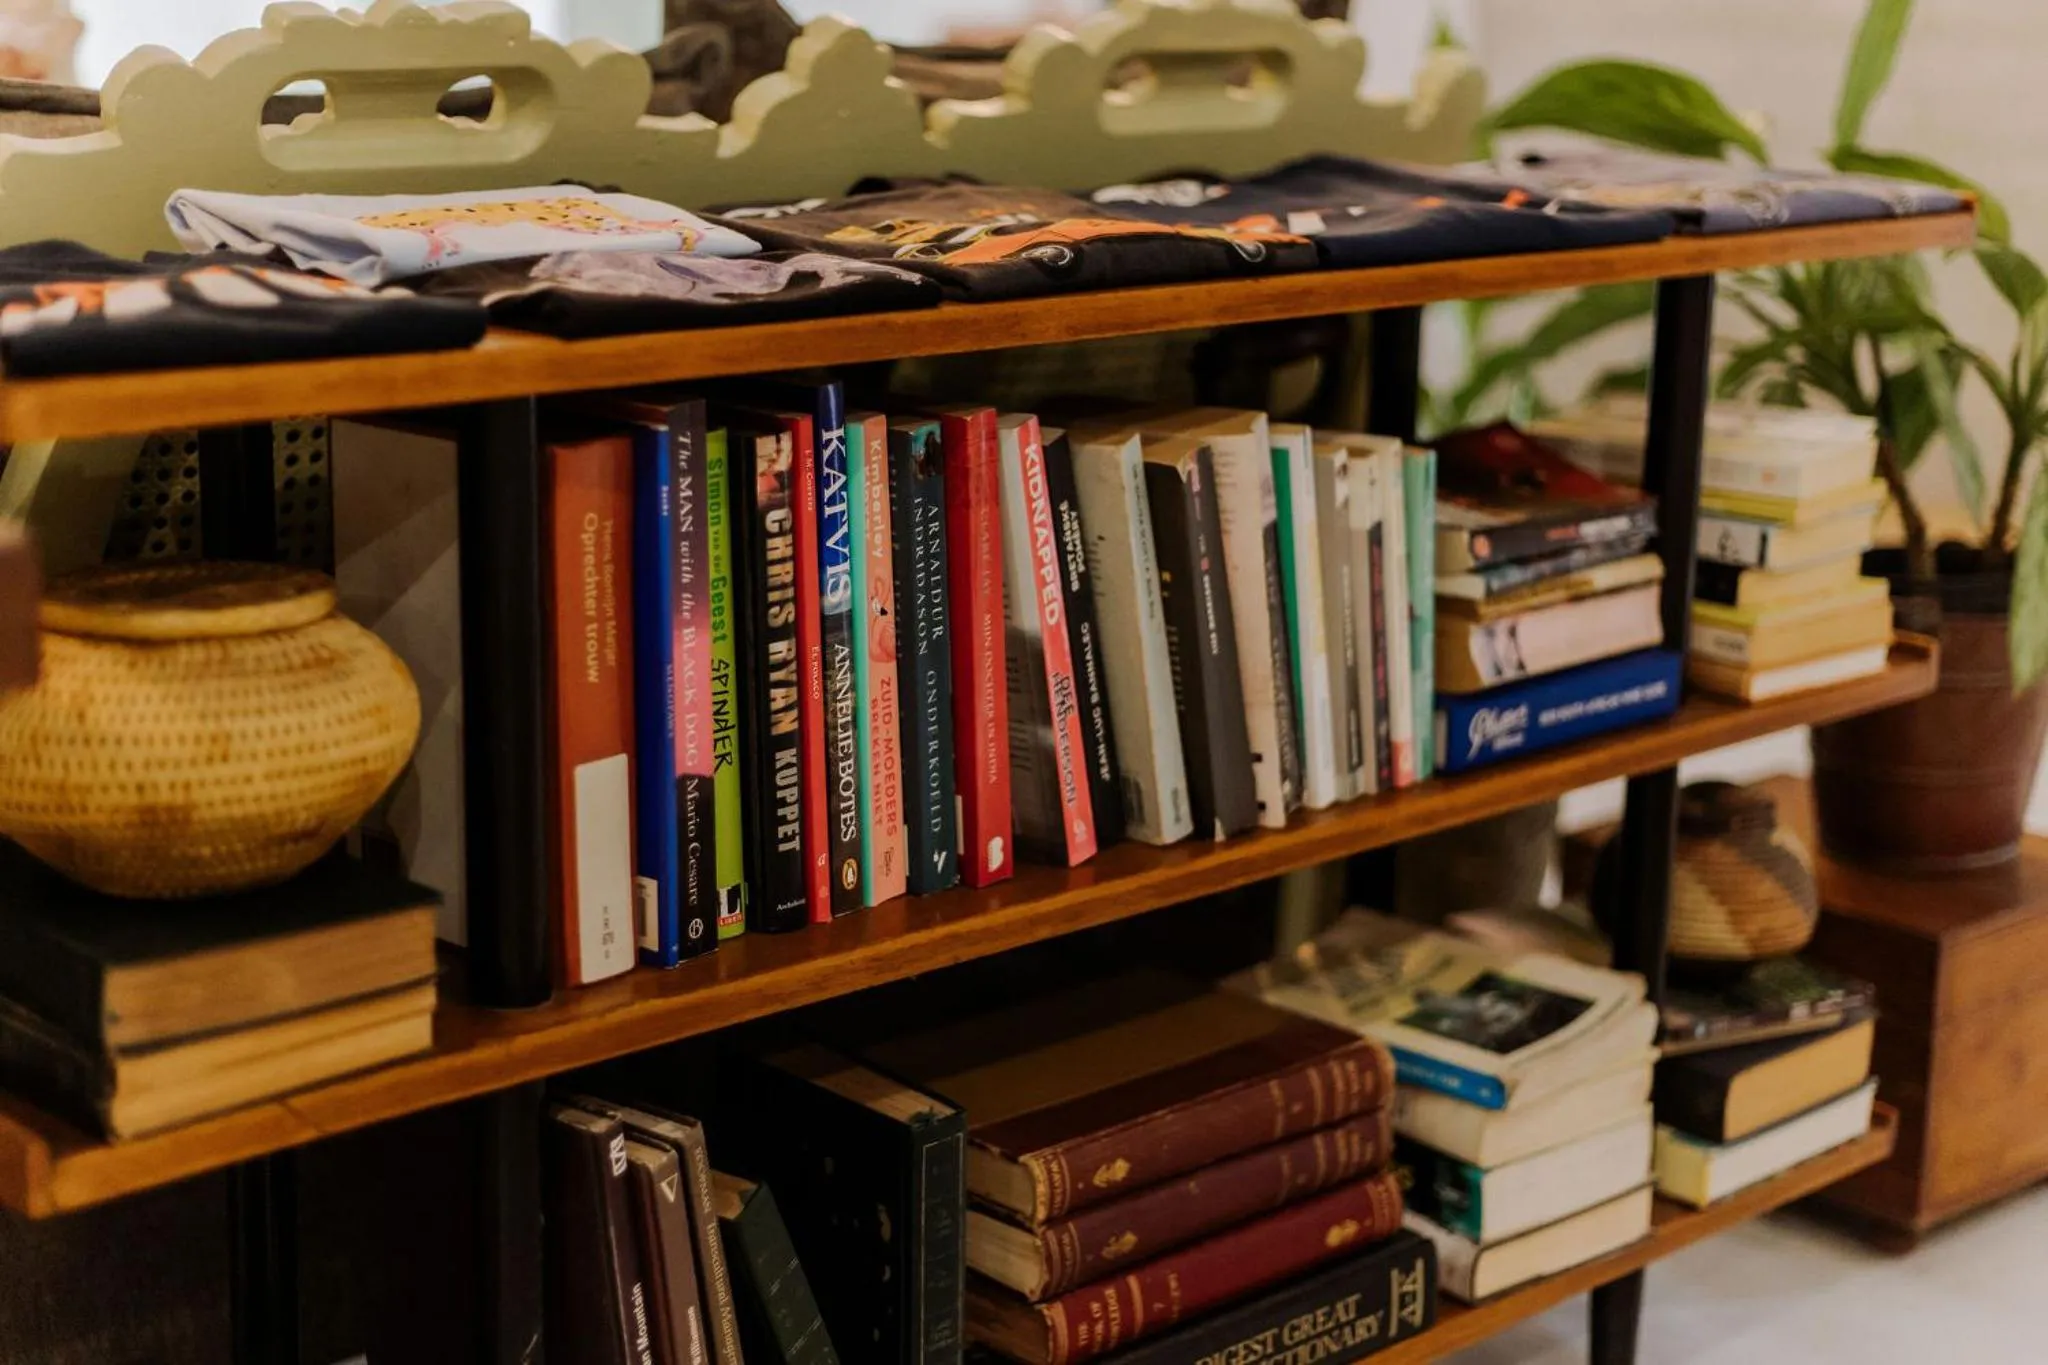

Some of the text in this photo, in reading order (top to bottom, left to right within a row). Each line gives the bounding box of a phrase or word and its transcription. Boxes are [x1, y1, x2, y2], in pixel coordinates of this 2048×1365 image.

[708, 458, 724, 527] Simon
[822, 423, 852, 603] KATVIS
[869, 439, 886, 560] Kimberley
[1024, 442, 1060, 626] KIDNAPPED
[581, 512, 601, 683] Oprechter trouw
[678, 431, 699, 766] The MAN with the BLACK DOG
[711, 574, 728, 645] Geest
[766, 507, 798, 736] CHRIS RYAN
[913, 497, 928, 656] INDRIDASON
[927, 504, 944, 640] ARNALDUR
[834, 644, 857, 842] ANNELIE BOTES
[926, 669, 943, 832] ONDERKOELD
[987, 722, 996, 739] IN
[1052, 672, 1077, 807] HENDERSON
[1060, 674, 1075, 718] DEE
[1080, 622, 1111, 782] JEAN-LUC BANNALEC
[687, 778, 700, 837] Mario
[775, 748, 800, 852] KUPPET
[632, 1281, 649, 1351] Mountain
[707, 1221, 730, 1302] Transcultural
[1283, 1293, 1362, 1345] GREAT
